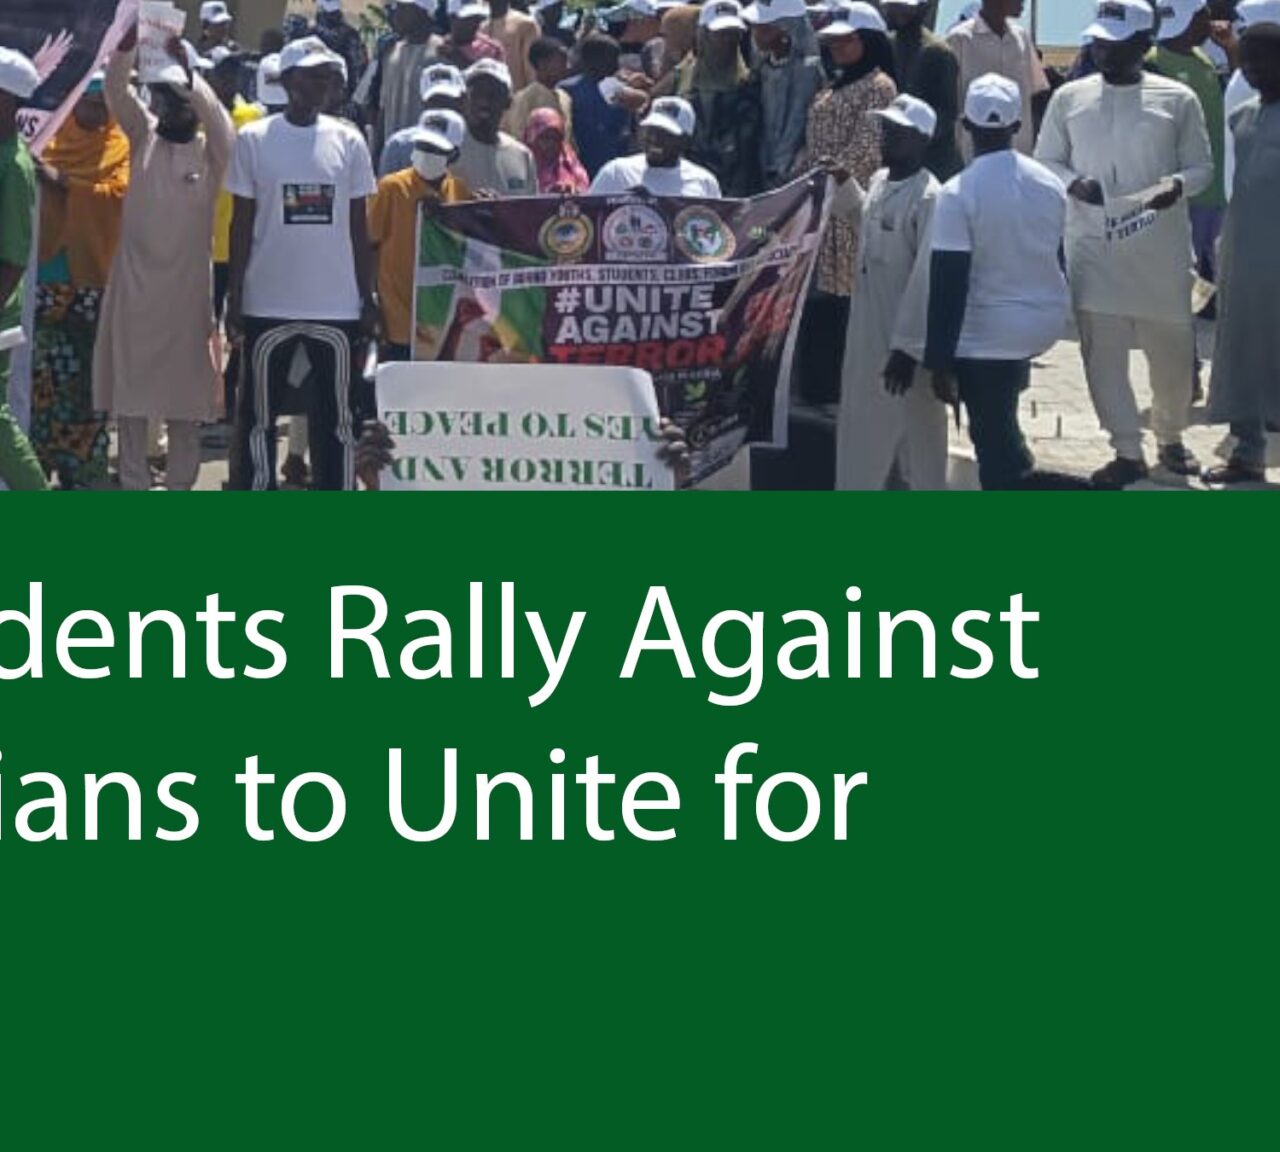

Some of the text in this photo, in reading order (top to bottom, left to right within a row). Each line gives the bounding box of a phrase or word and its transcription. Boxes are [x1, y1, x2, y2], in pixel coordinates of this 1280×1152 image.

[554, 284, 715, 314] #UNITE
[555, 309, 724, 344] AGAINST
[549, 334, 727, 371] TERROR
[384, 410, 510, 437] PEACE
[521, 411, 577, 438] TO
[583, 412, 662, 442] YES
[390, 455, 653, 488] TERROR AND
